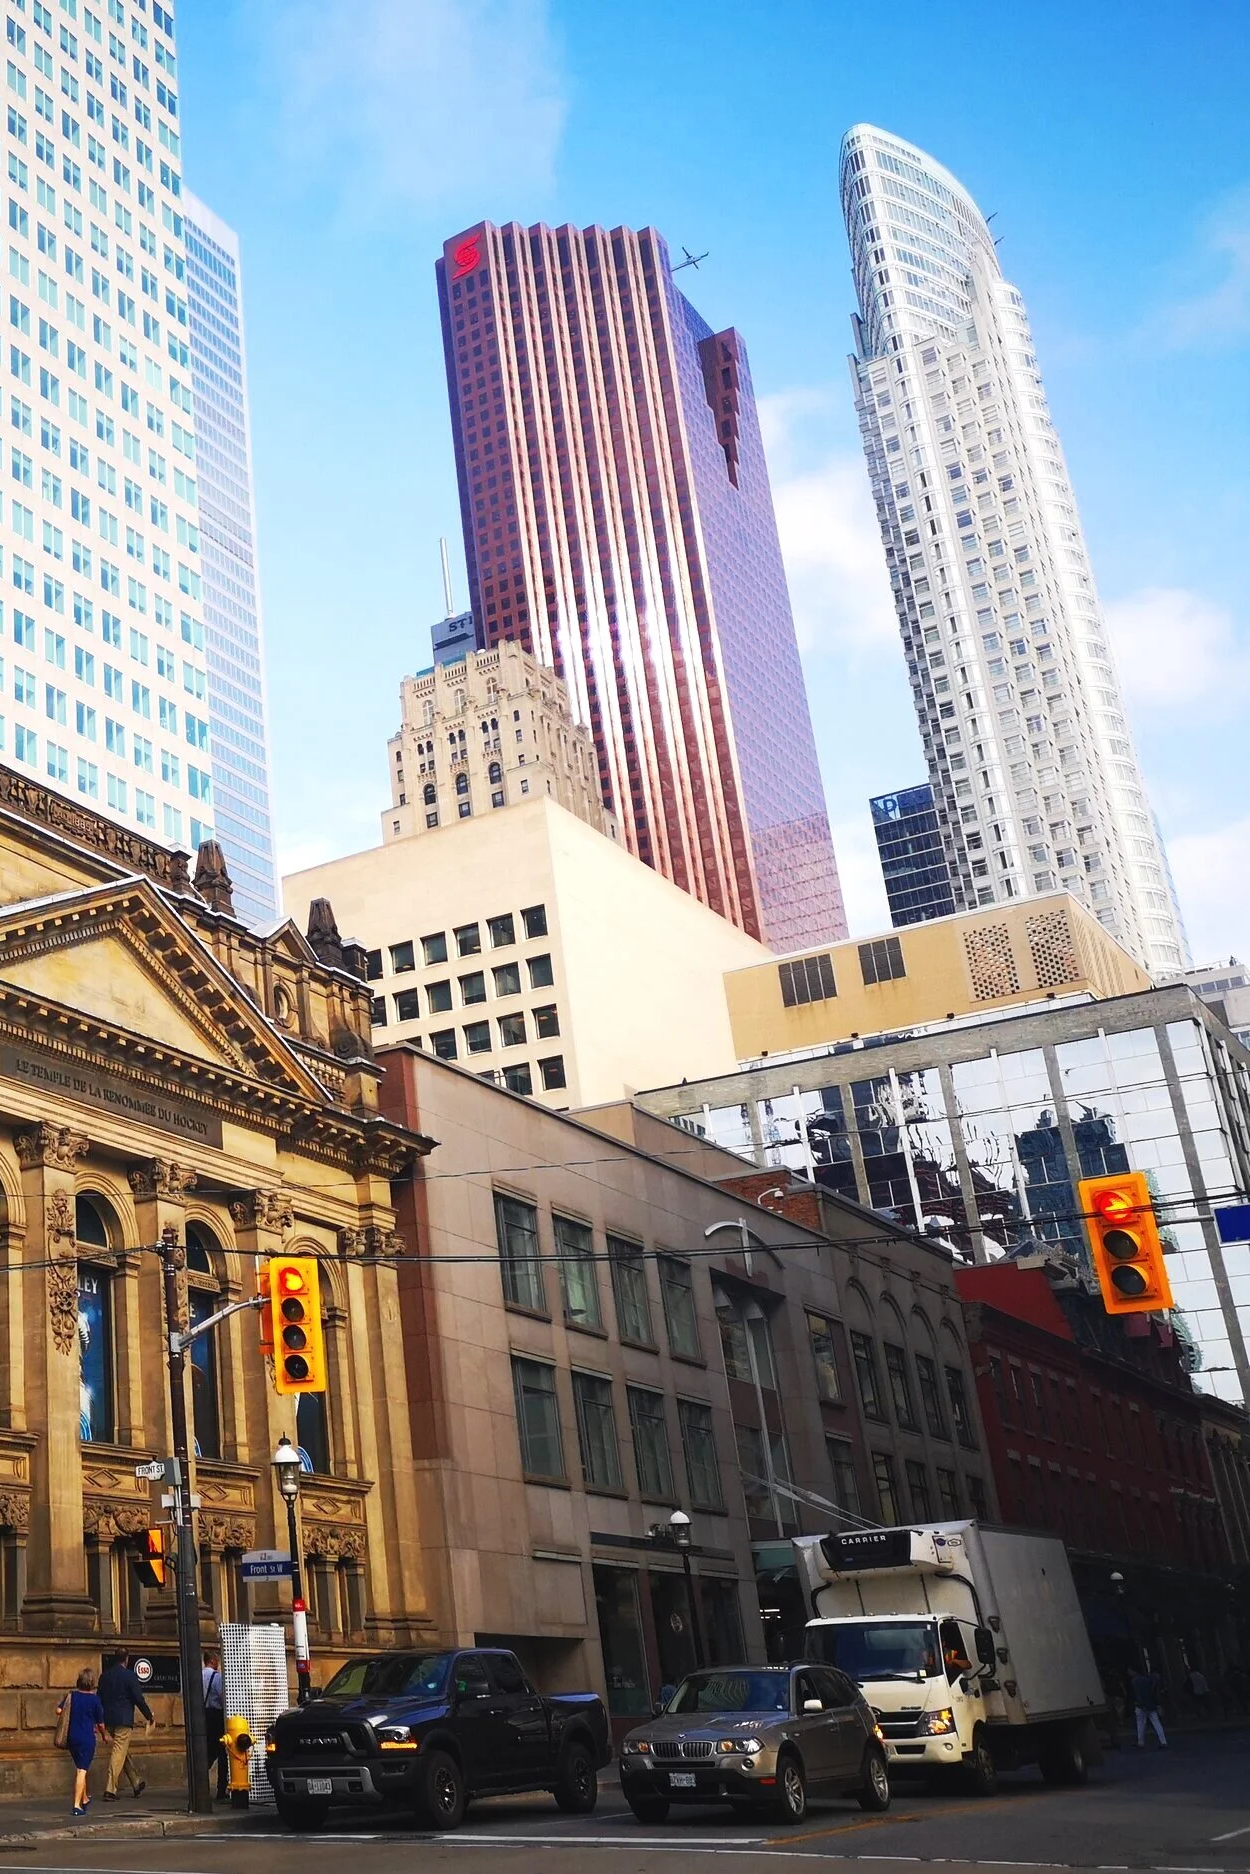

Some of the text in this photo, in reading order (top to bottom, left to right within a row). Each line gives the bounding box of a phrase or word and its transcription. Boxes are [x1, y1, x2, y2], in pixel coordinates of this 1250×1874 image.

[16, 1058, 30, 1074] LE
[30, 1063, 71, 1088] TEMPLE
[72, 1077, 87, 1093] DE
[89, 1083, 102, 1098] LA
[158, 1107, 171, 1122] DU
[173, 1112, 208, 1135] HOCKEY
[137, 1465, 156, 1476] FRONT
[841, 1535, 887, 1545] CARRIER
[250, 1564, 268, 1574] Front
[277, 1563, 283, 1573] W
[137, 1665, 150, 1675] Esso
